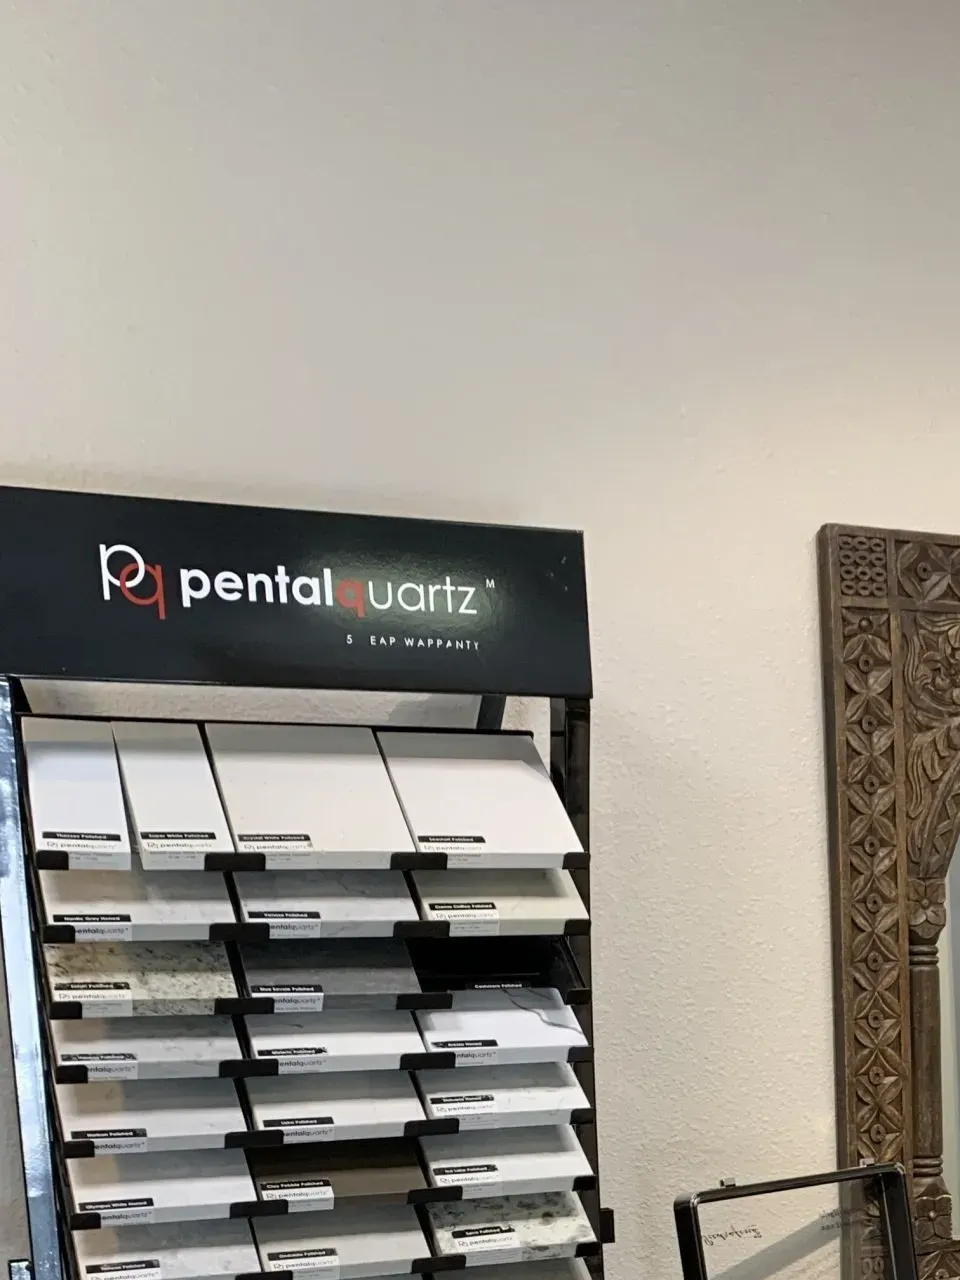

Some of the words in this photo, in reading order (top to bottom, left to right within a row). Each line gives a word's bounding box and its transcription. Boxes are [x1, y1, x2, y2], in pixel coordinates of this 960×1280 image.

[179, 565, 478, 618] pentalquartz
[75, 927, 125, 935] entalquartz
[273, 997, 317, 1005] entalquartz
[279, 1059, 322, 1067] entalquartz
[87, 1065, 132, 1073] entalquartz
[283, 1129, 329, 1137] entalquartz
[94, 1142, 141, 1150] entalquartz
[101, 1212, 148, 1221] entalquartz
